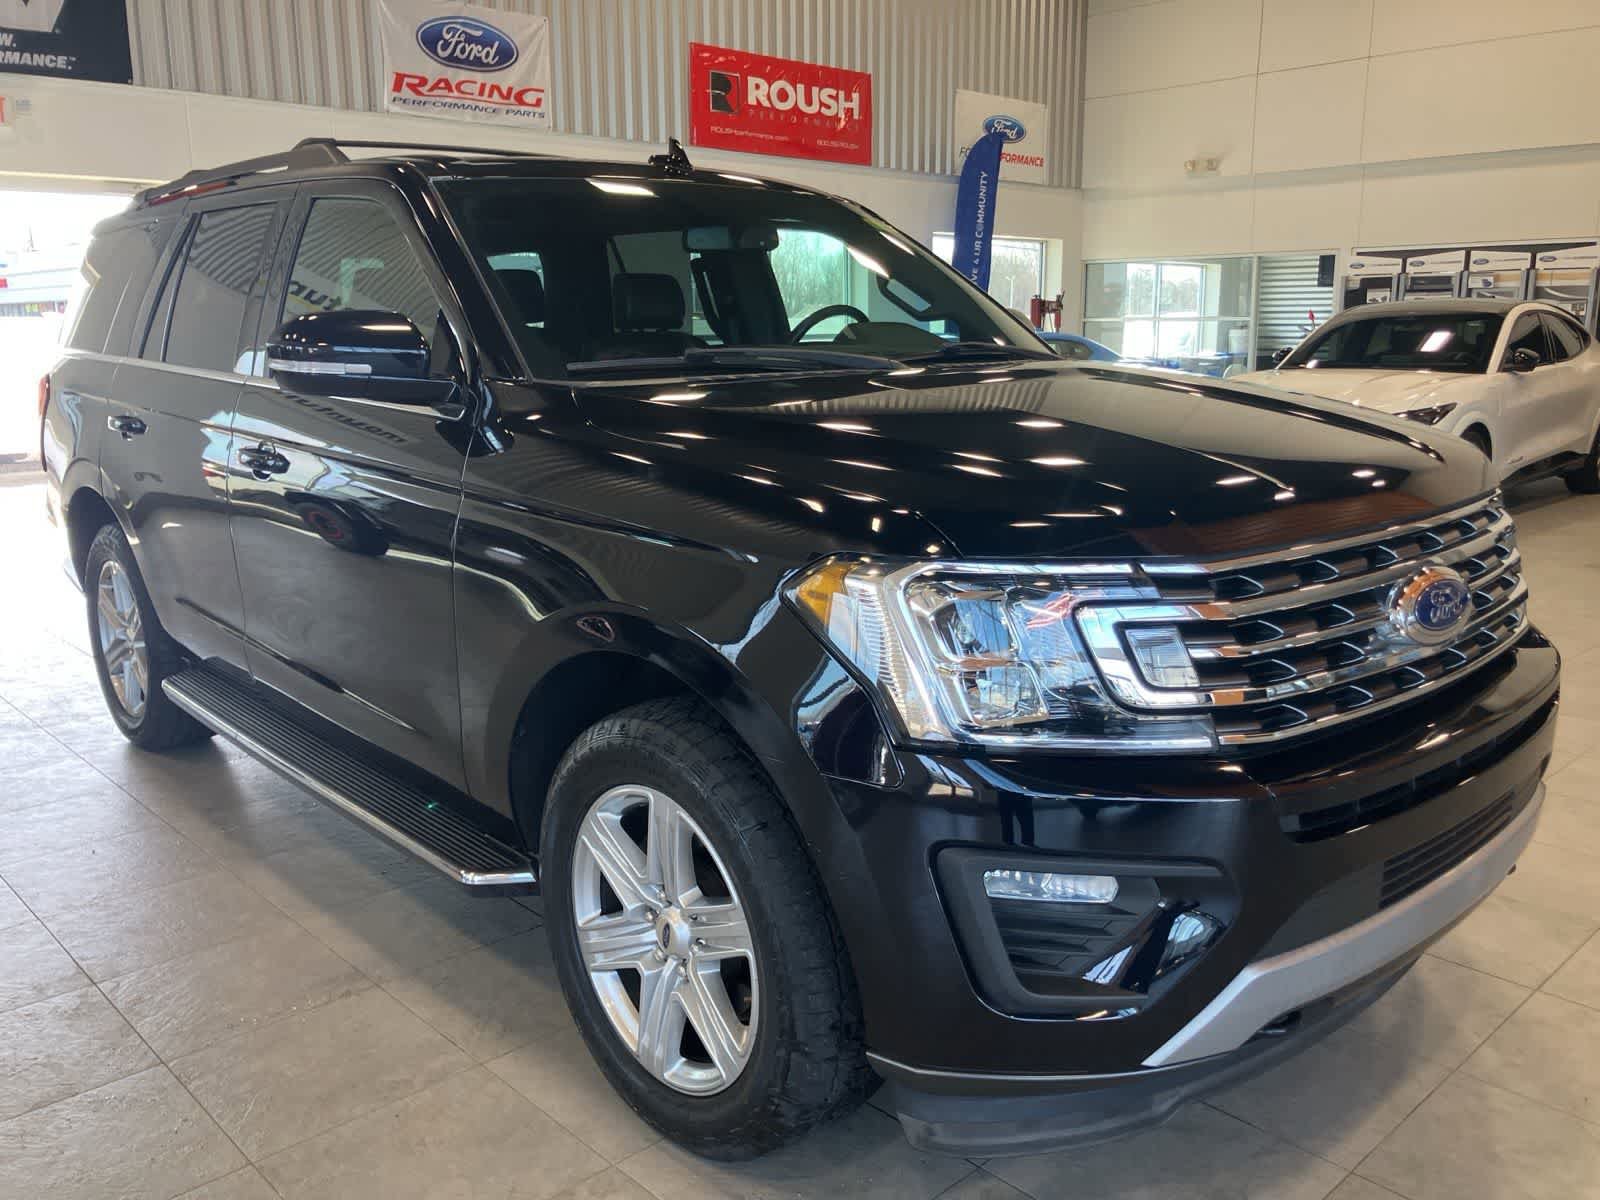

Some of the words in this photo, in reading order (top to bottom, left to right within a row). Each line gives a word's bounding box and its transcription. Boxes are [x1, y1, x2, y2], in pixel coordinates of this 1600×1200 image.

[437, 23, 500, 65] Ford
[391, 72, 544, 108] RACING
[392, 97, 498, 114] PERFORMANCE
[505, 109, 545, 120] PARTS
[747, 76, 861, 120] ROUSH
[975, 171, 989, 238] COMMUNITY
[1429, 586, 1463, 624] Ford
